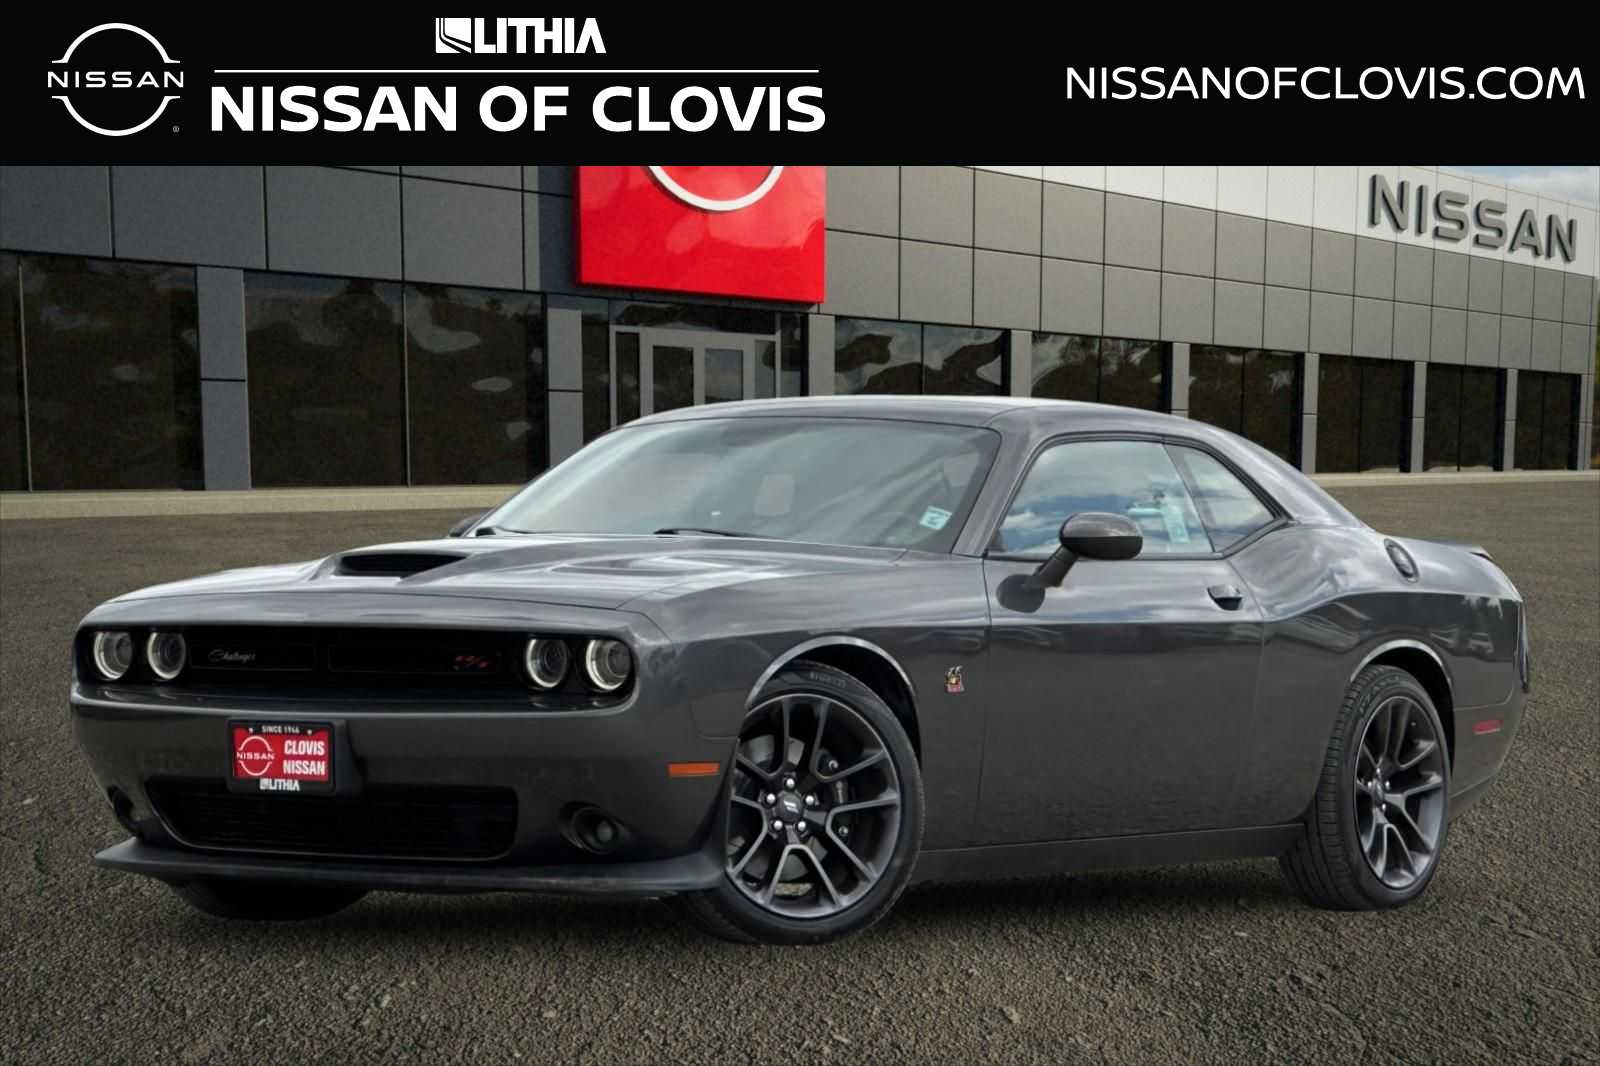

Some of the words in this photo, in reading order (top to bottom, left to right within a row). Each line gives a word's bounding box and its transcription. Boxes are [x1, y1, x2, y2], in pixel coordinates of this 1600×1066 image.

[1368, 173, 1578, 263] NISSAN
[262, 725, 282, 733] SINCE
[284, 740, 325, 756] CLOVIS
[236, 751, 275, 760] NISSAN
[283, 759, 326, 775] NISSAN
[269, 779, 301, 791] LITHIA
